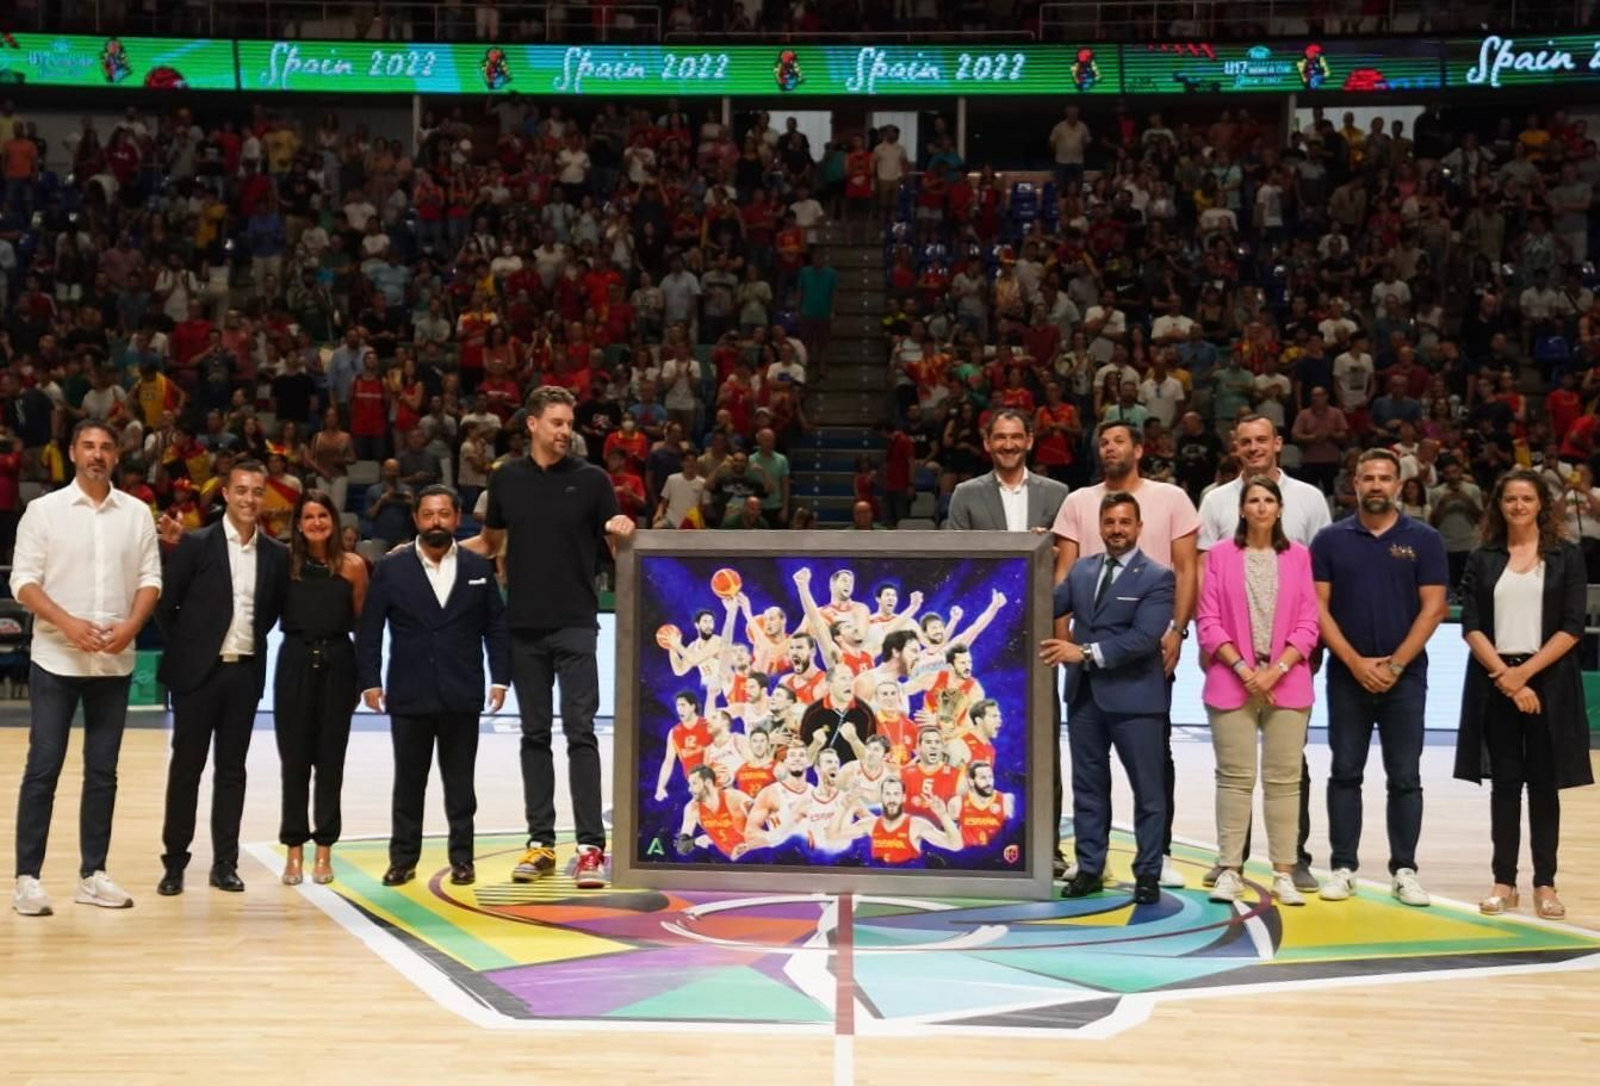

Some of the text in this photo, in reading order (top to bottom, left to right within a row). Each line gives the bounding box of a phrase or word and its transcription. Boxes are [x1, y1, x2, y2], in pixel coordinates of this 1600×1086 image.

[260, 42, 436, 90] Spain 2022
[553, 47, 728, 94] Spain 2022
[845, 47, 1025, 94] Spain 2022
[1224, 61, 1247, 75] U17
[1466, 35, 1576, 87] Spain
